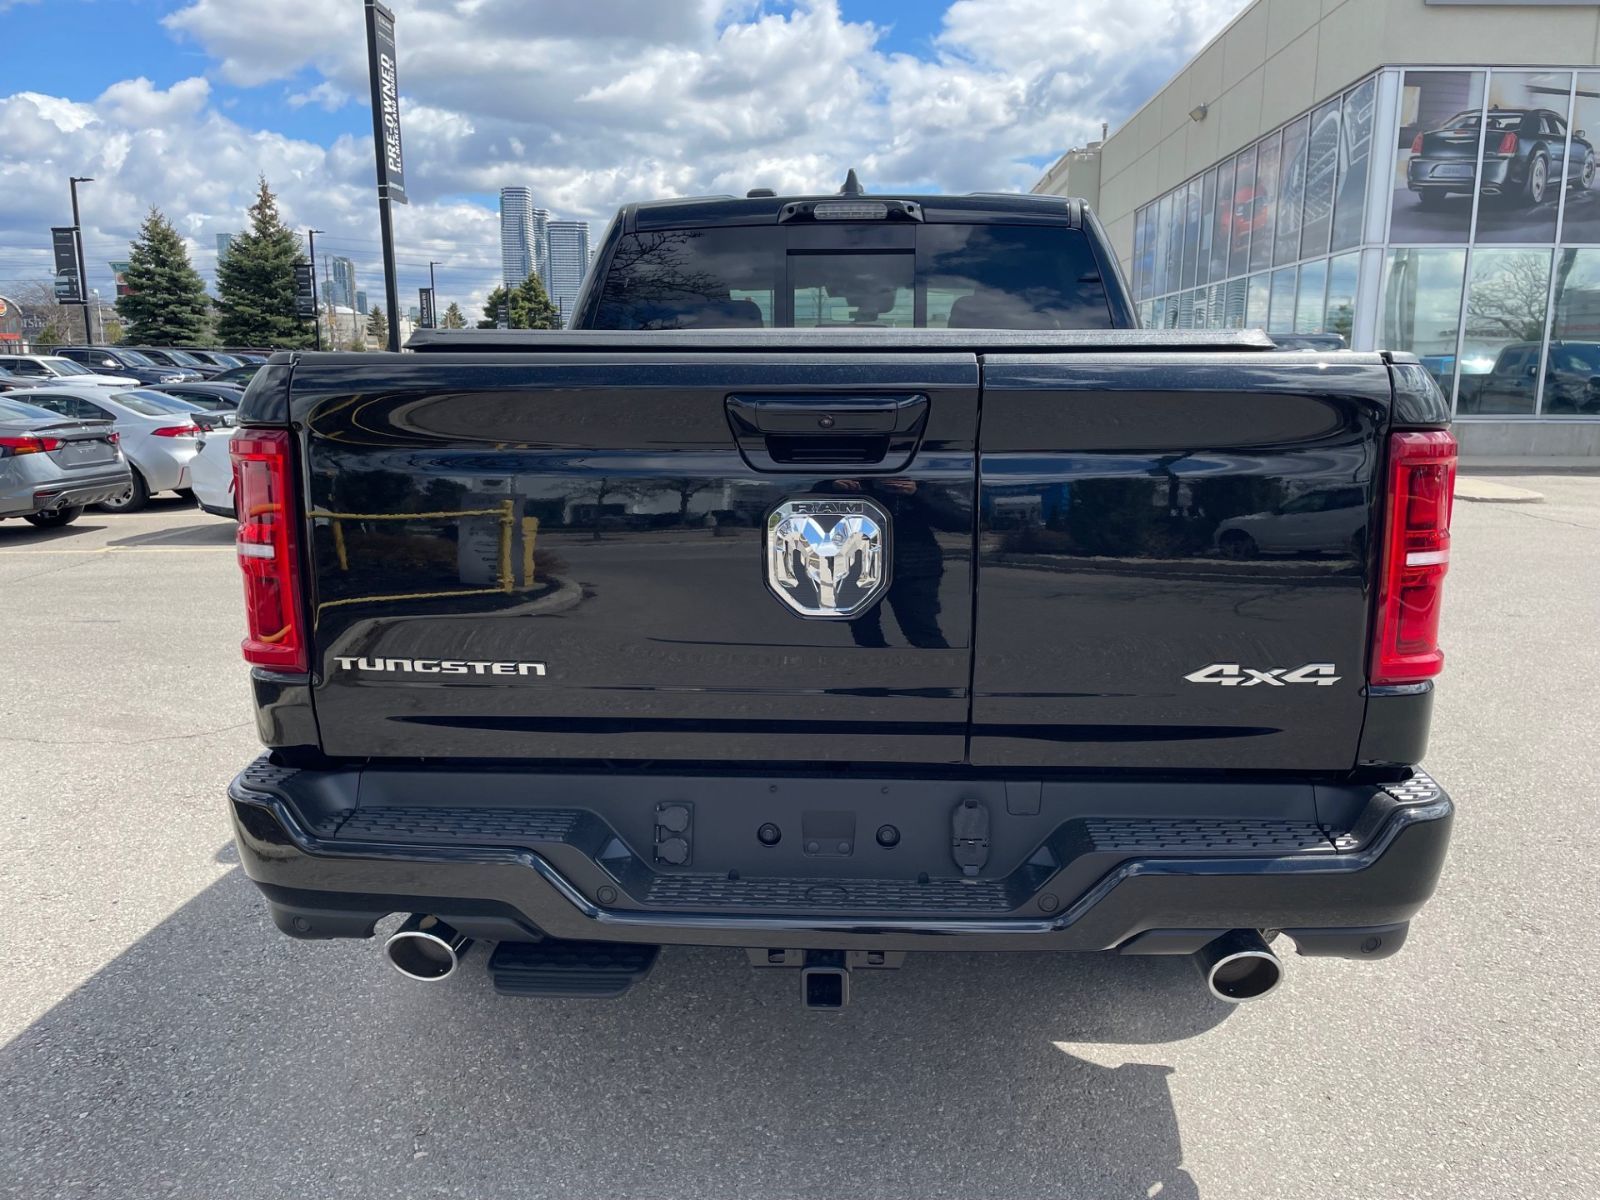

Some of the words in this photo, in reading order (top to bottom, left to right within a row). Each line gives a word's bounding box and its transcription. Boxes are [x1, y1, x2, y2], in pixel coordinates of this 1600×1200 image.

[380, 53, 398, 172] PRE-OWNED
[792, 503, 864, 513] RAM
[333, 656, 546, 676] TUNGSTEN
